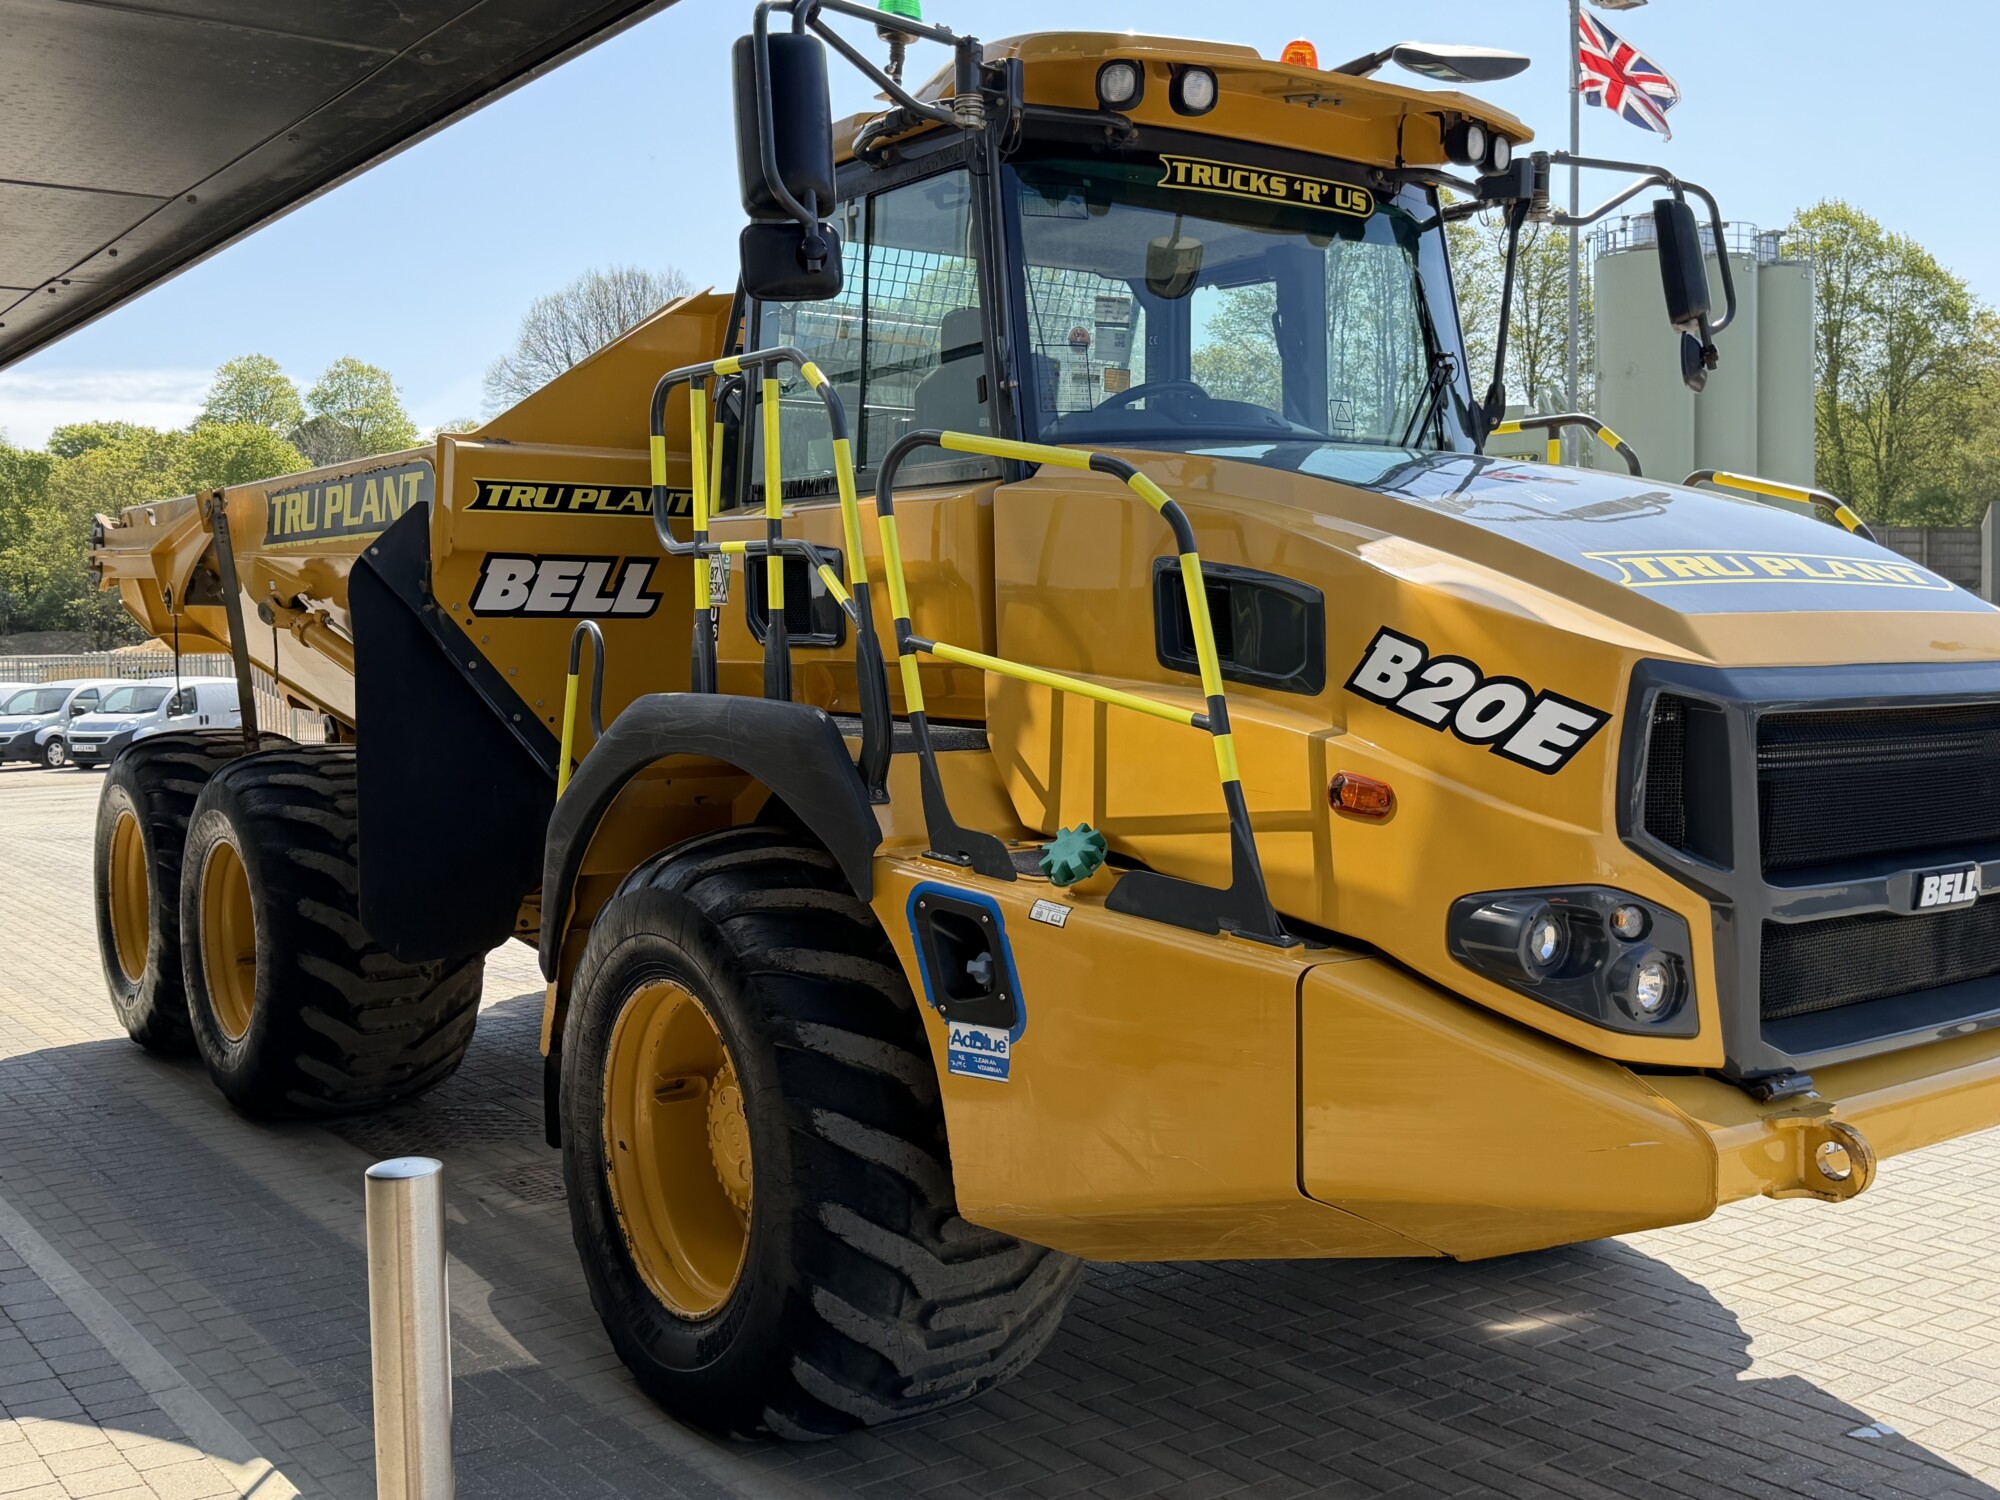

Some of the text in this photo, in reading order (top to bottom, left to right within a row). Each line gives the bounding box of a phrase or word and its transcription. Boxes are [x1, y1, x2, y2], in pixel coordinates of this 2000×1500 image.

[1171, 161, 1288, 198] TRUCKS
[1335, 188, 1368, 213] US
[272, 470, 424, 536] TRU PLANT
[485, 484, 564, 508] TRU
[472, 557, 657, 613] BELL
[1617, 554, 1931, 585] TRU PLANT
[1352, 632, 1599, 767] B20E
[1919, 869, 1977, 907] BELL
